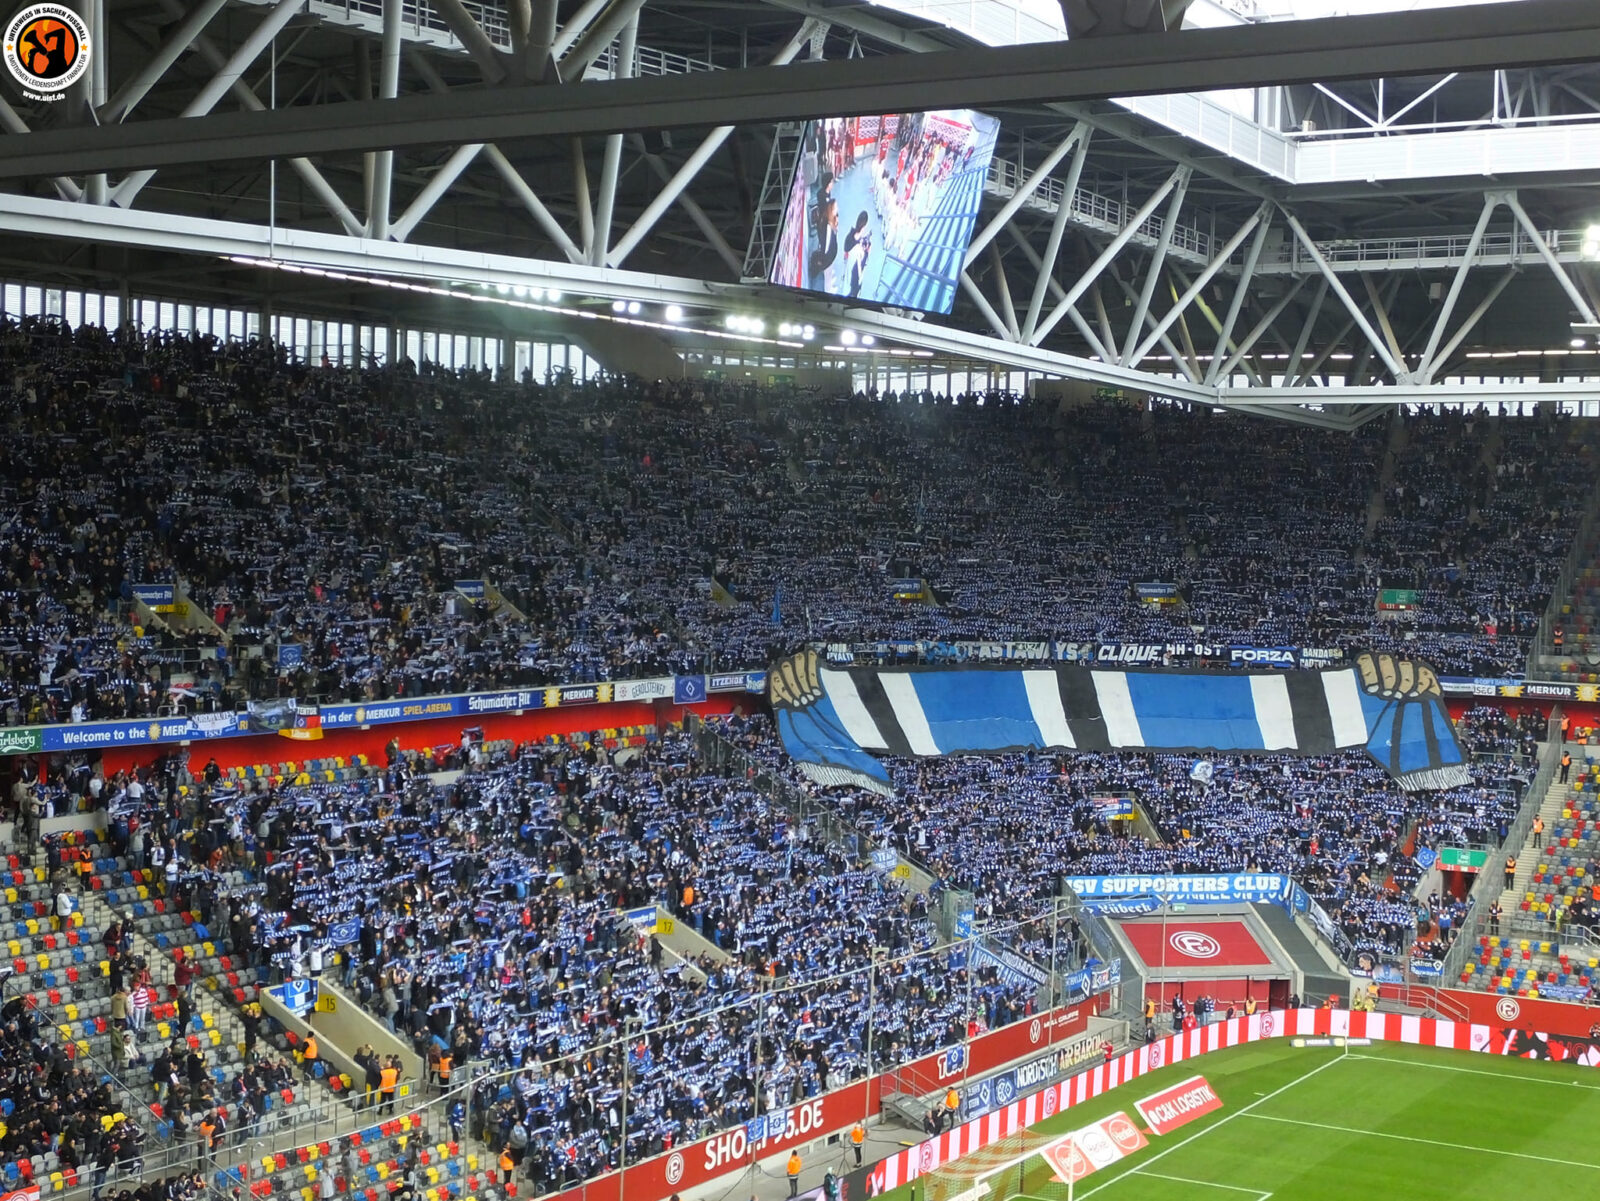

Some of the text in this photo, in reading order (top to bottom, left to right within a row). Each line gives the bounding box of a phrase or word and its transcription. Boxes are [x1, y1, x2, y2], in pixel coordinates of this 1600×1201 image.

[1231, 650, 1295, 662] FORZA
[563, 689, 594, 701] MERKUR
[632, 681, 666, 698] GEROLSTEINER
[1527, 685, 1571, 696] MERKUR
[469, 692, 531, 711] Schumacher Alt
[327, 713, 336, 723] in
[338, 712, 353, 723] der
[366, 707, 400, 720] MERKUR
[403, 703, 452, 716] SPIEL-ARENA
[0, 731, 35, 749] arlsberg
[63, 725, 187, 744] Welcome to the MER
[1102, 877, 1229, 893] SUPPORTERS
[1233, 876, 1281, 891] CLUB
[326, 997, 336, 1010] 15
[1172, 1085, 1216, 1114] LOGISTIK
